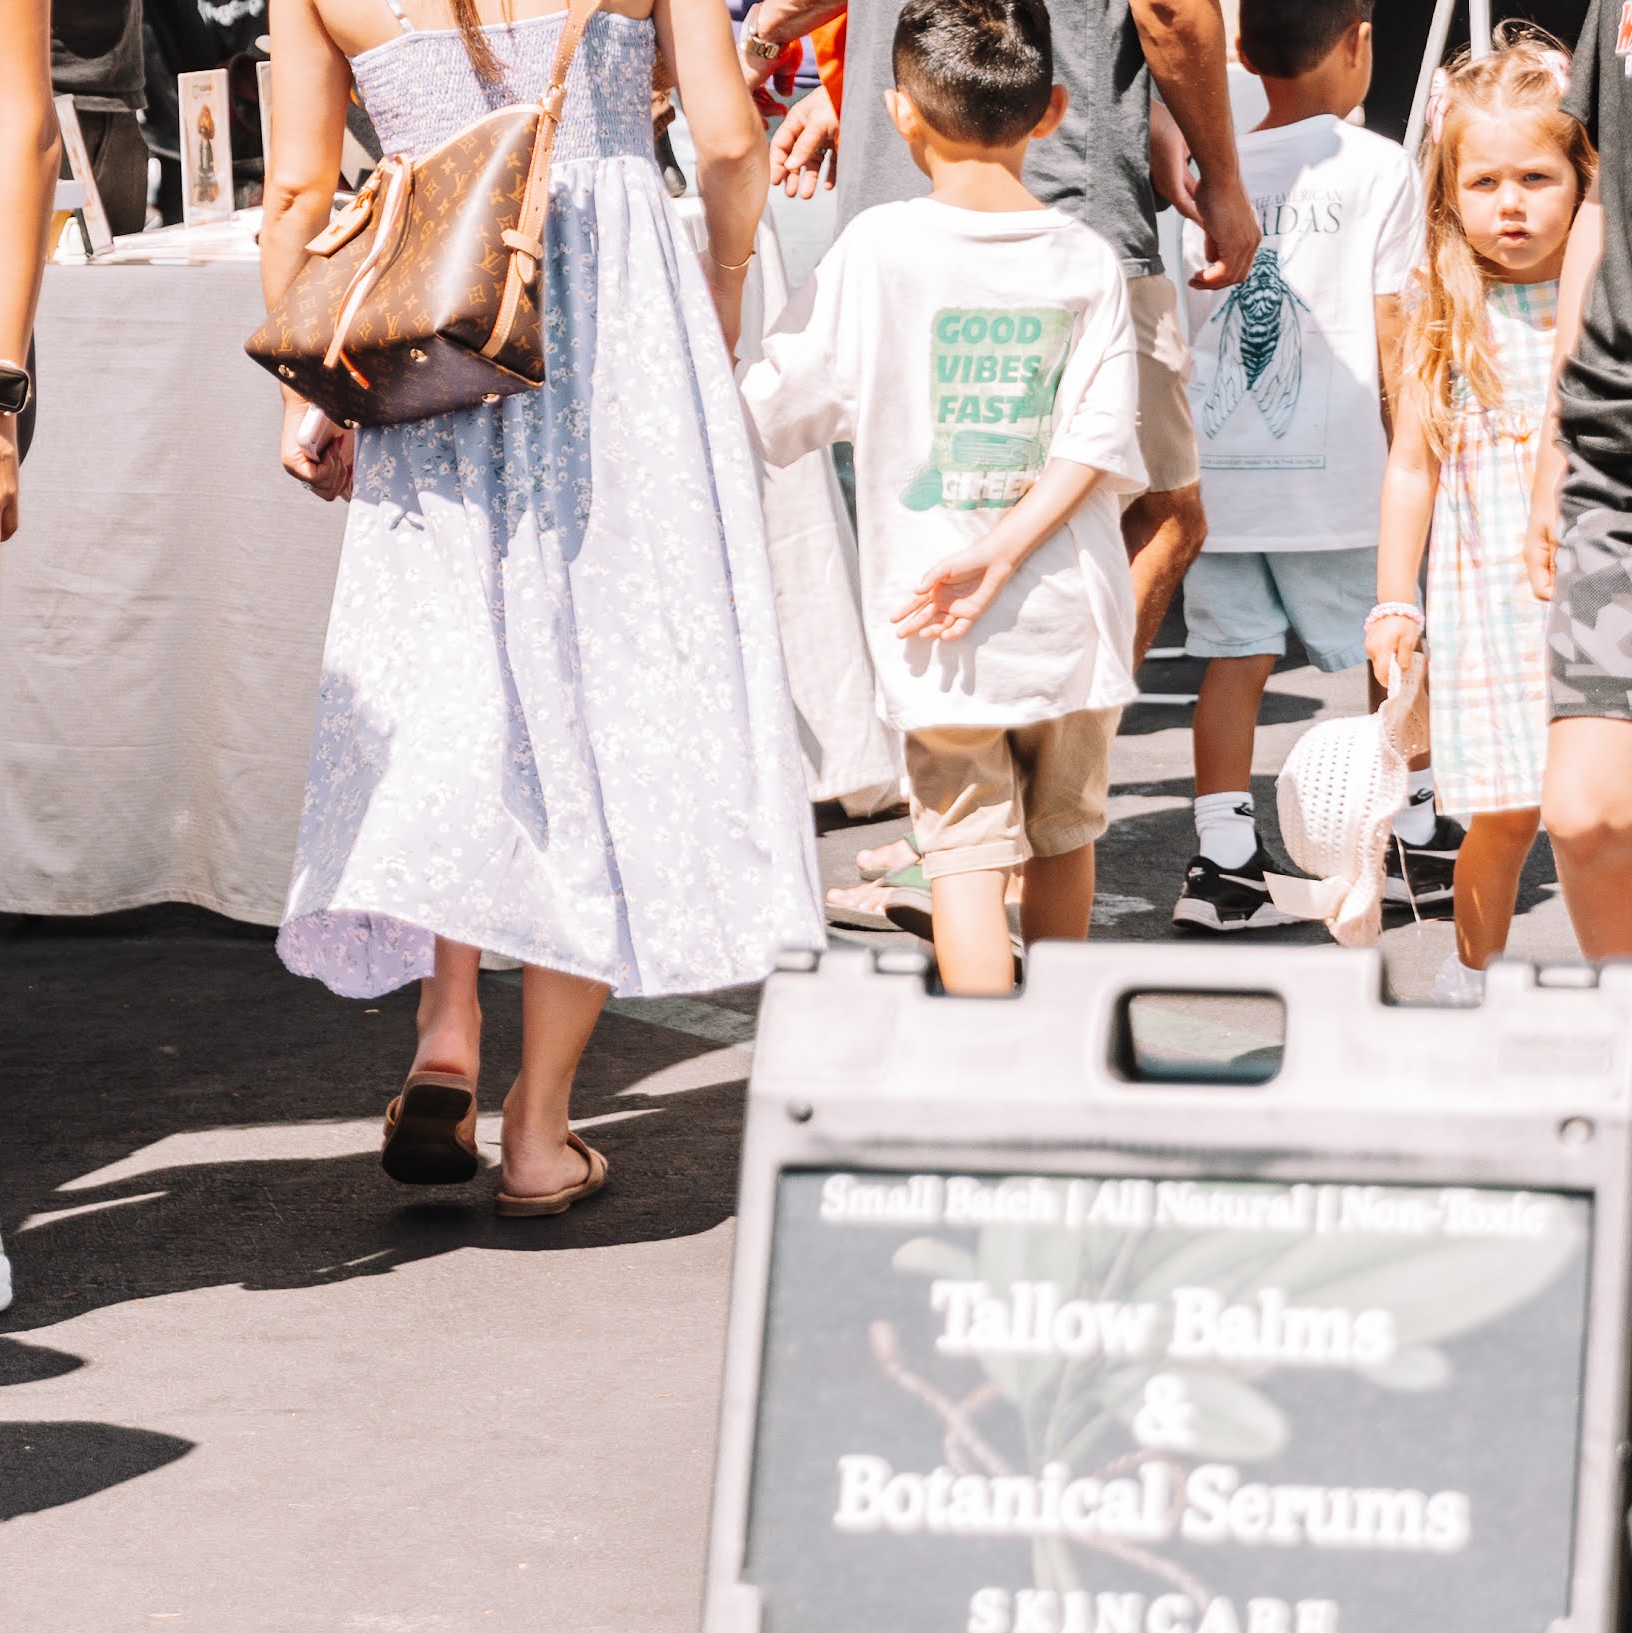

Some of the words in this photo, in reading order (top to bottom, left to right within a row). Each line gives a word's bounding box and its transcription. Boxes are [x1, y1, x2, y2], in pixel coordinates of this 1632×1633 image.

[935, 315, 1043, 345] GOOD
[935, 354, 1043, 384] VIBES
[937, 395, 1027, 424] FAST
[821, 1174, 944, 1220] Small
[945, 1176, 1059, 1224] Batch
[1087, 1178, 1154, 1226] All
[1156, 1180, 1312, 1230] Natural
[931, 1279, 1160, 1360] Tallow
[1170, 1285, 1395, 1366] Balms
[1132, 1373, 1197, 1450] &
[833, 1452, 1171, 1536] Botanical
[1180, 1461, 1473, 1552] Serums
